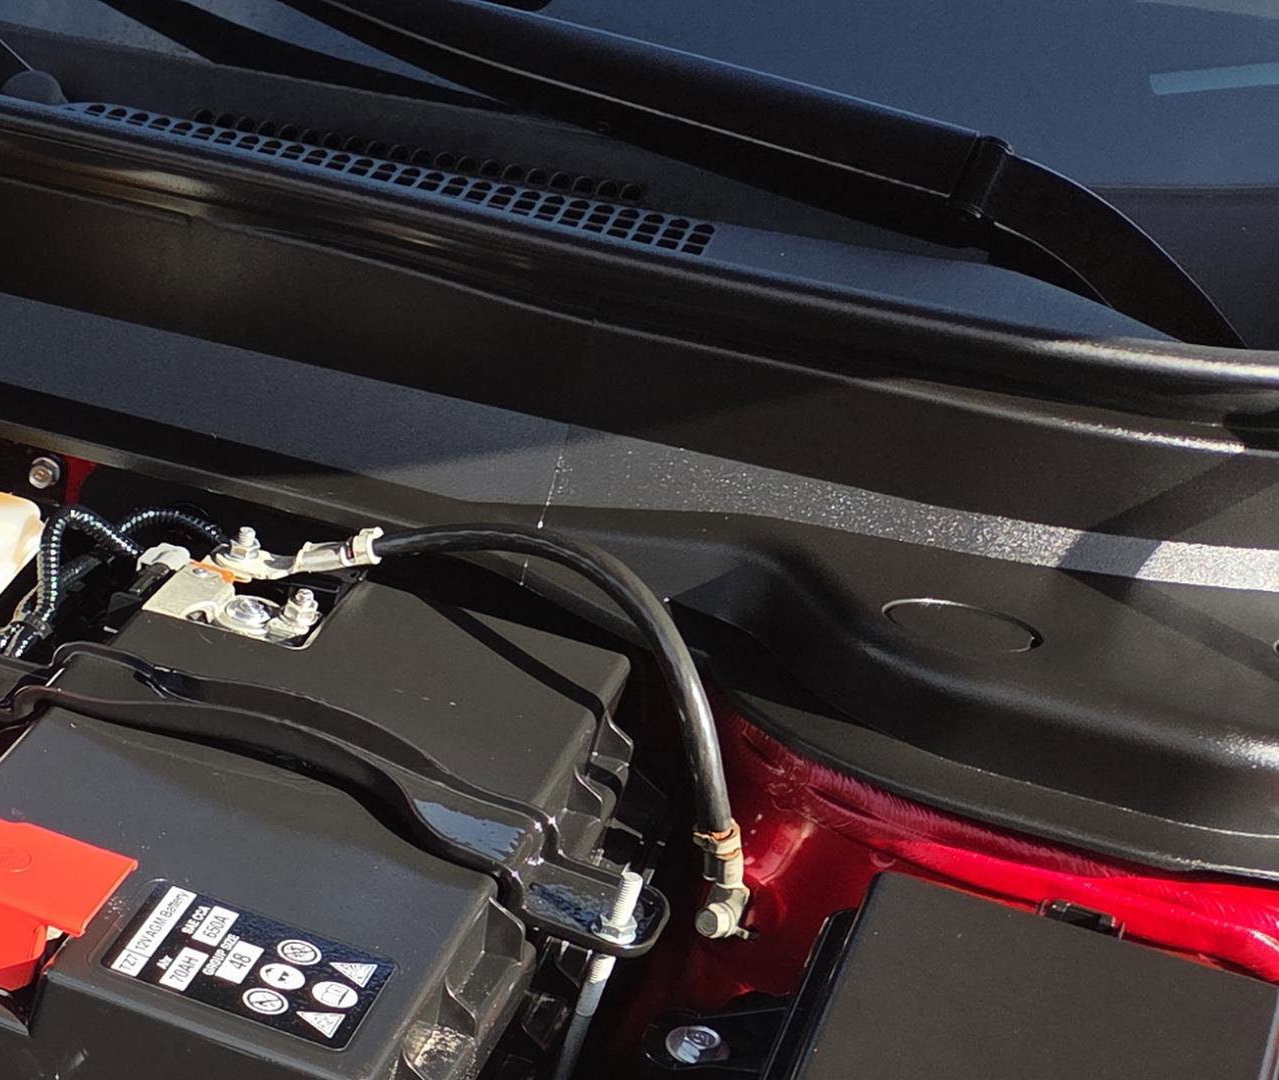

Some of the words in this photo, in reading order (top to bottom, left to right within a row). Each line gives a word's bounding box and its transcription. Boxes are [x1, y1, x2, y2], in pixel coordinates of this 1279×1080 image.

[192, 905, 211, 921] CCA
[119, 953, 138, 970] TZ7
[135, 936, 150, 950] 12V
[148, 919, 167, 938] AGM
[160, 892, 189, 918] Battery
[203, 915, 230, 939] 650A
[202, 949, 227, 976] GROUP
[220, 934, 240, 950] SIZE
[229, 953, 251, 970] 48
[170, 956, 199, 983] 70AH
